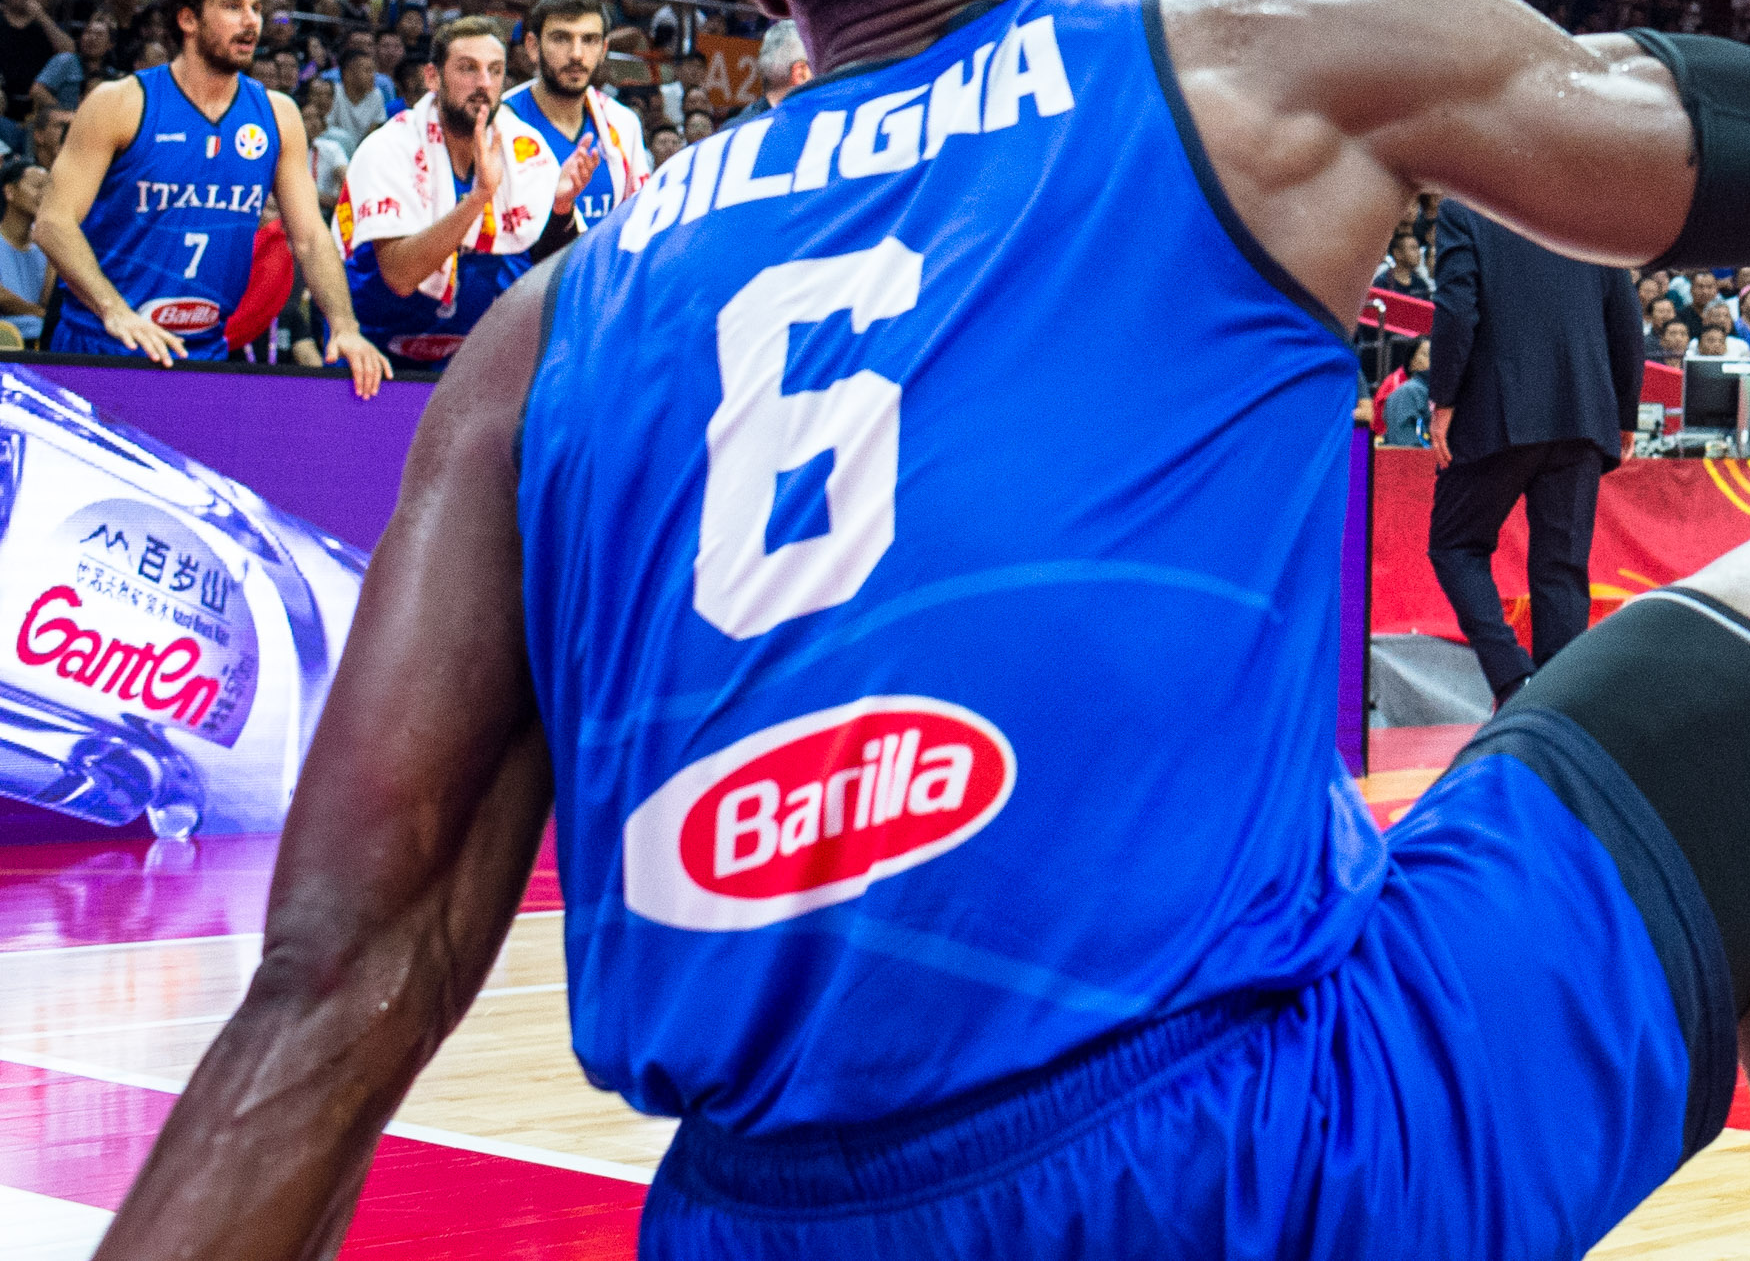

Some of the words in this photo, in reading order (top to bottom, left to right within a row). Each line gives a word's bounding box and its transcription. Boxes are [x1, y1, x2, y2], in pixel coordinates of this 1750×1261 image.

[705, 50, 759, 102] A2
[135, 180, 263, 216] ITALIA
[183, 232, 209, 279] 7
[157, 305, 219, 324] Barilla
[693, 236, 924, 640] 6
[138, 535, 230, 614] 百岁山
[16, 585, 220, 727] Ganten
[713, 728, 975, 879] Barilla
